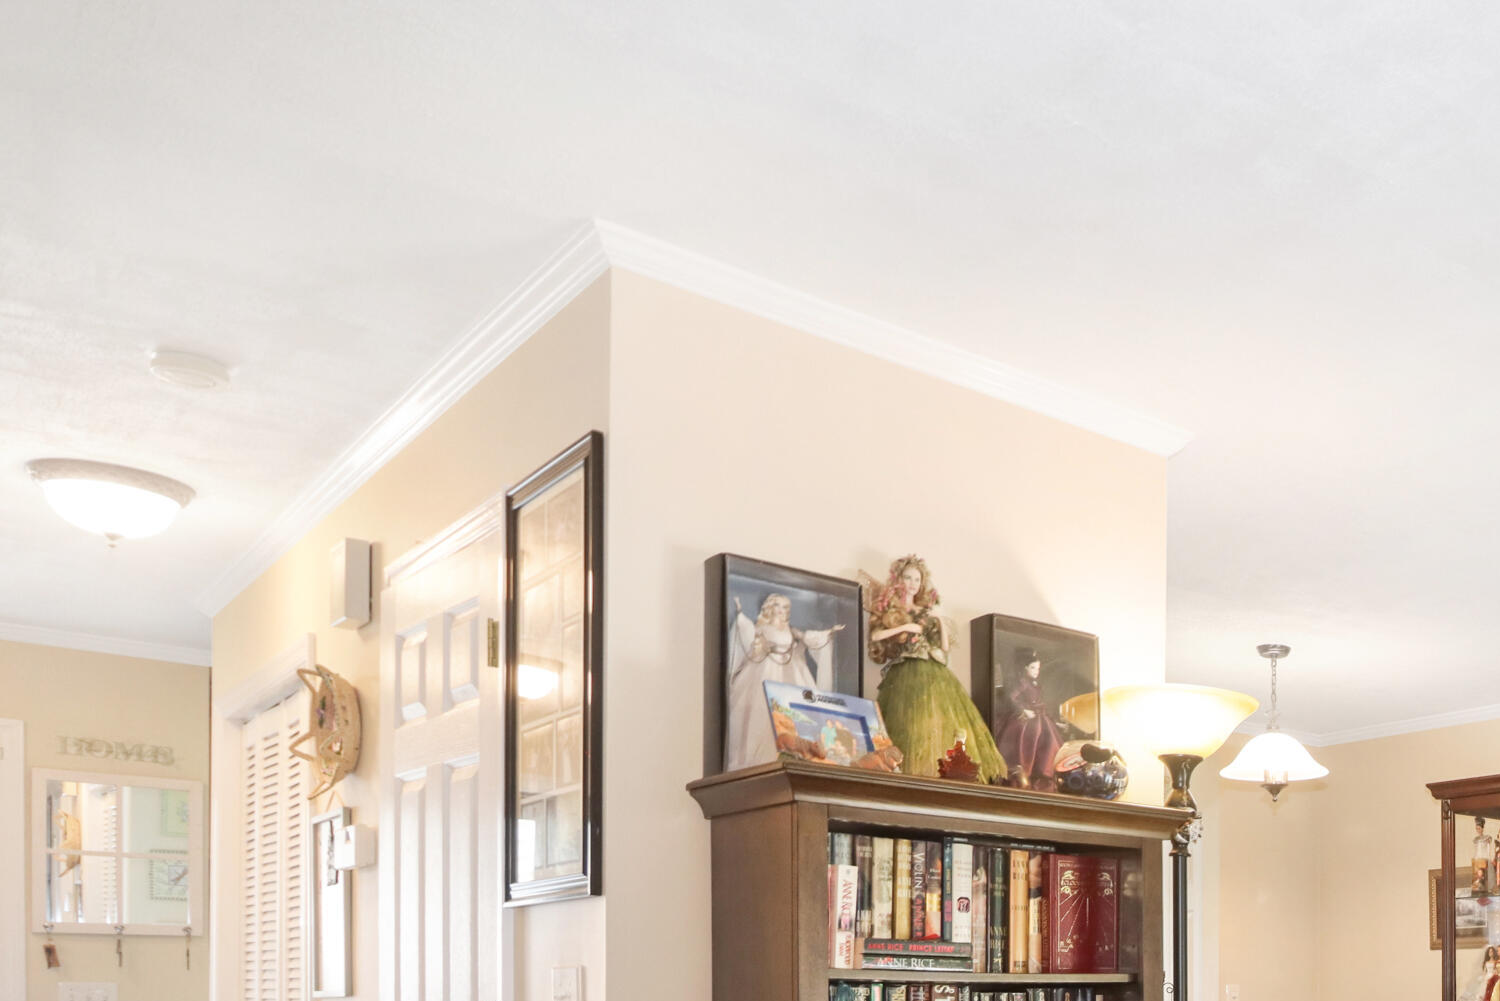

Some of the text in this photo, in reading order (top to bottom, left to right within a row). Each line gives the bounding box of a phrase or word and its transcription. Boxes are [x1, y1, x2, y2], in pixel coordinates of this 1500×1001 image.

[913, 852, 925, 889] VIOLIN
[877, 957, 935, 969] ANNE RICE
